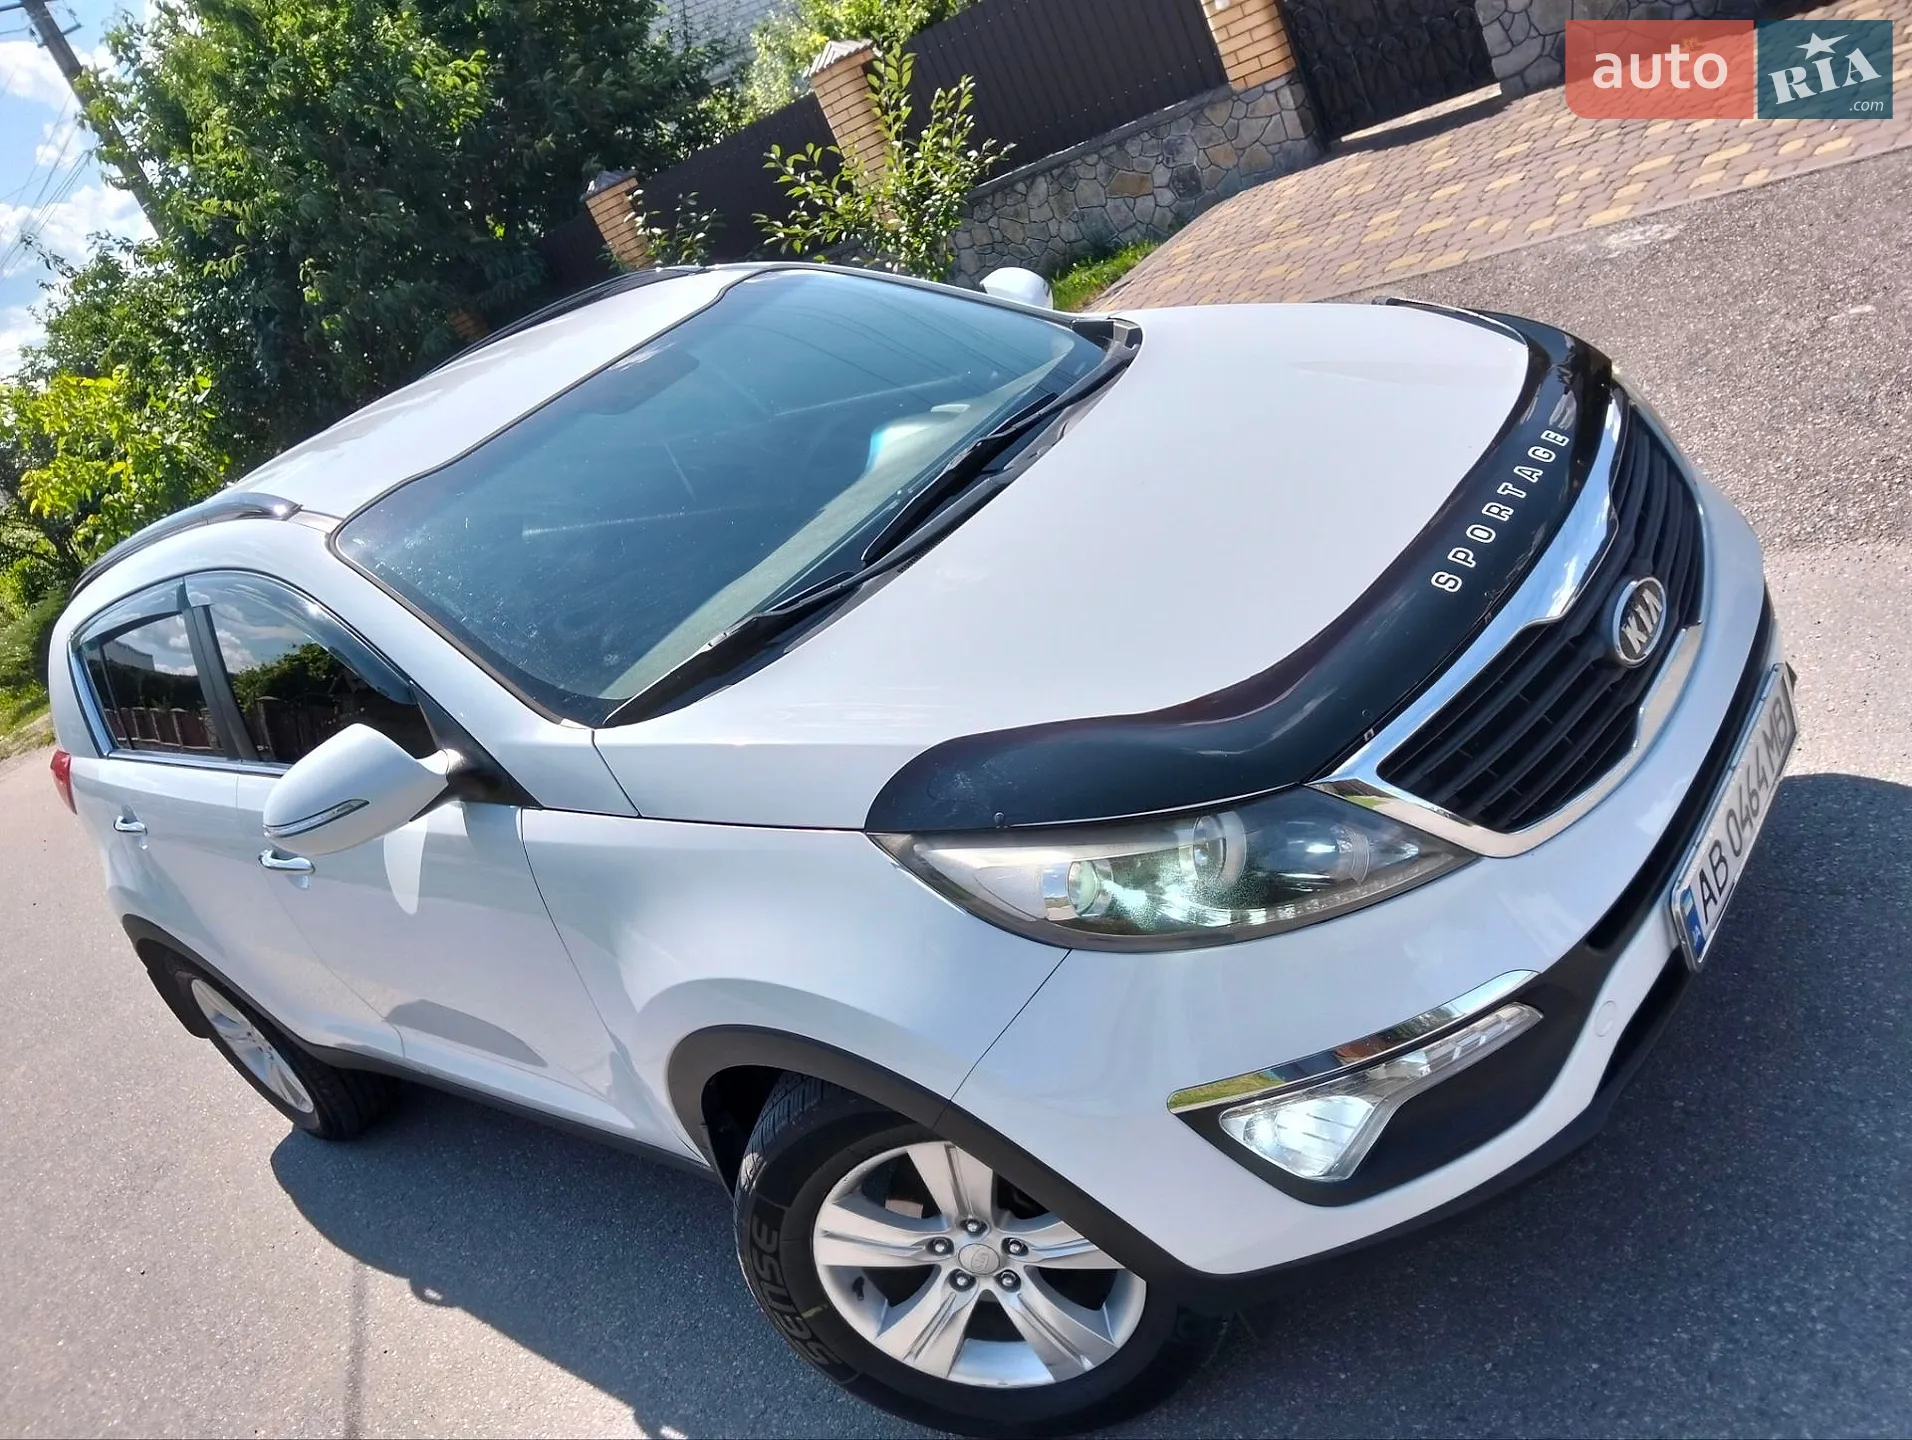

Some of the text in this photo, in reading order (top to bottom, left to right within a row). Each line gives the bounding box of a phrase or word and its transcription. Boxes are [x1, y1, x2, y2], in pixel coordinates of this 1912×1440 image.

[1431, 430, 1569, 592] SPORTAGE
[1622, 588, 1663, 654] KIA
[1699, 696, 1788, 924] AB 0464 MB
